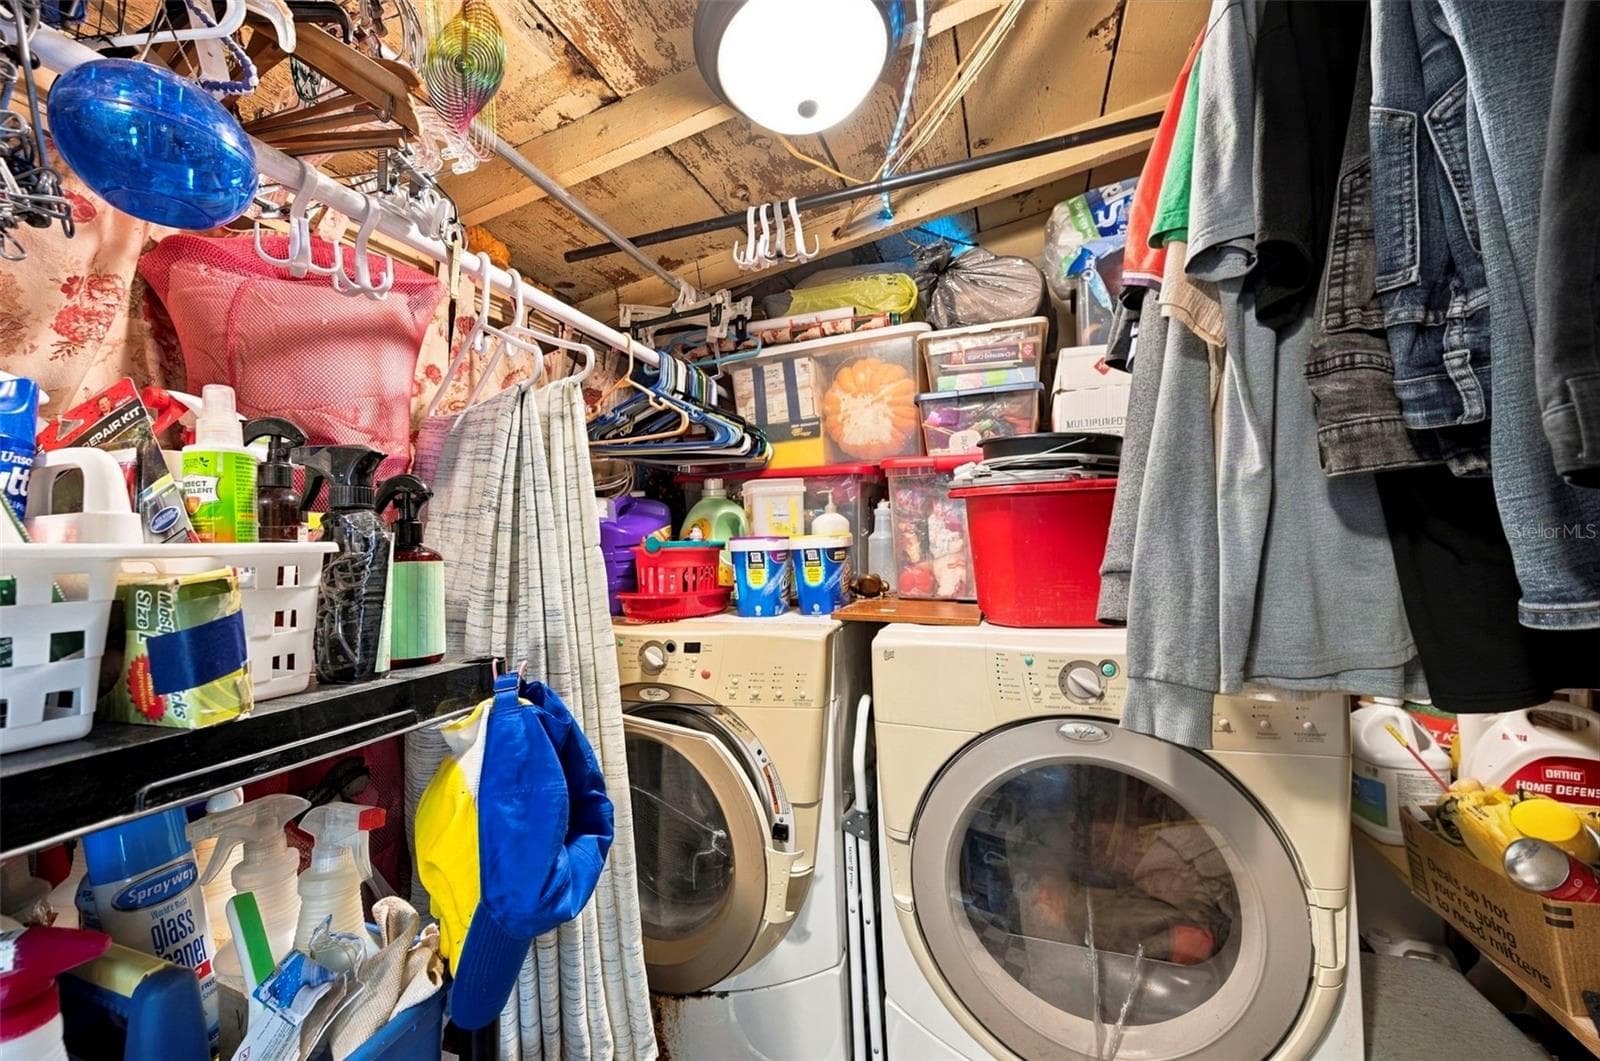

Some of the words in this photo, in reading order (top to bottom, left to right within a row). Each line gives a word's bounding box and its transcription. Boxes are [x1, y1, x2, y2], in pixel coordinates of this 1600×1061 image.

[121, 406, 141, 425] KIT
[136, 590, 151, 629] Size
[1516, 780, 1552, 793] HOME
[128, 867, 195, 904] Sprayway
[1427, 858, 1461, 890] Deals
[1464, 887, 1479, 902] so
[1482, 894, 1510, 923] hot
[151, 909, 195, 955] glass
[1436, 895, 1449, 913] to
[1453, 908, 1486, 940] need
[1490, 935, 1552, 990] mittens
[1475, 911, 1517, 949] going
